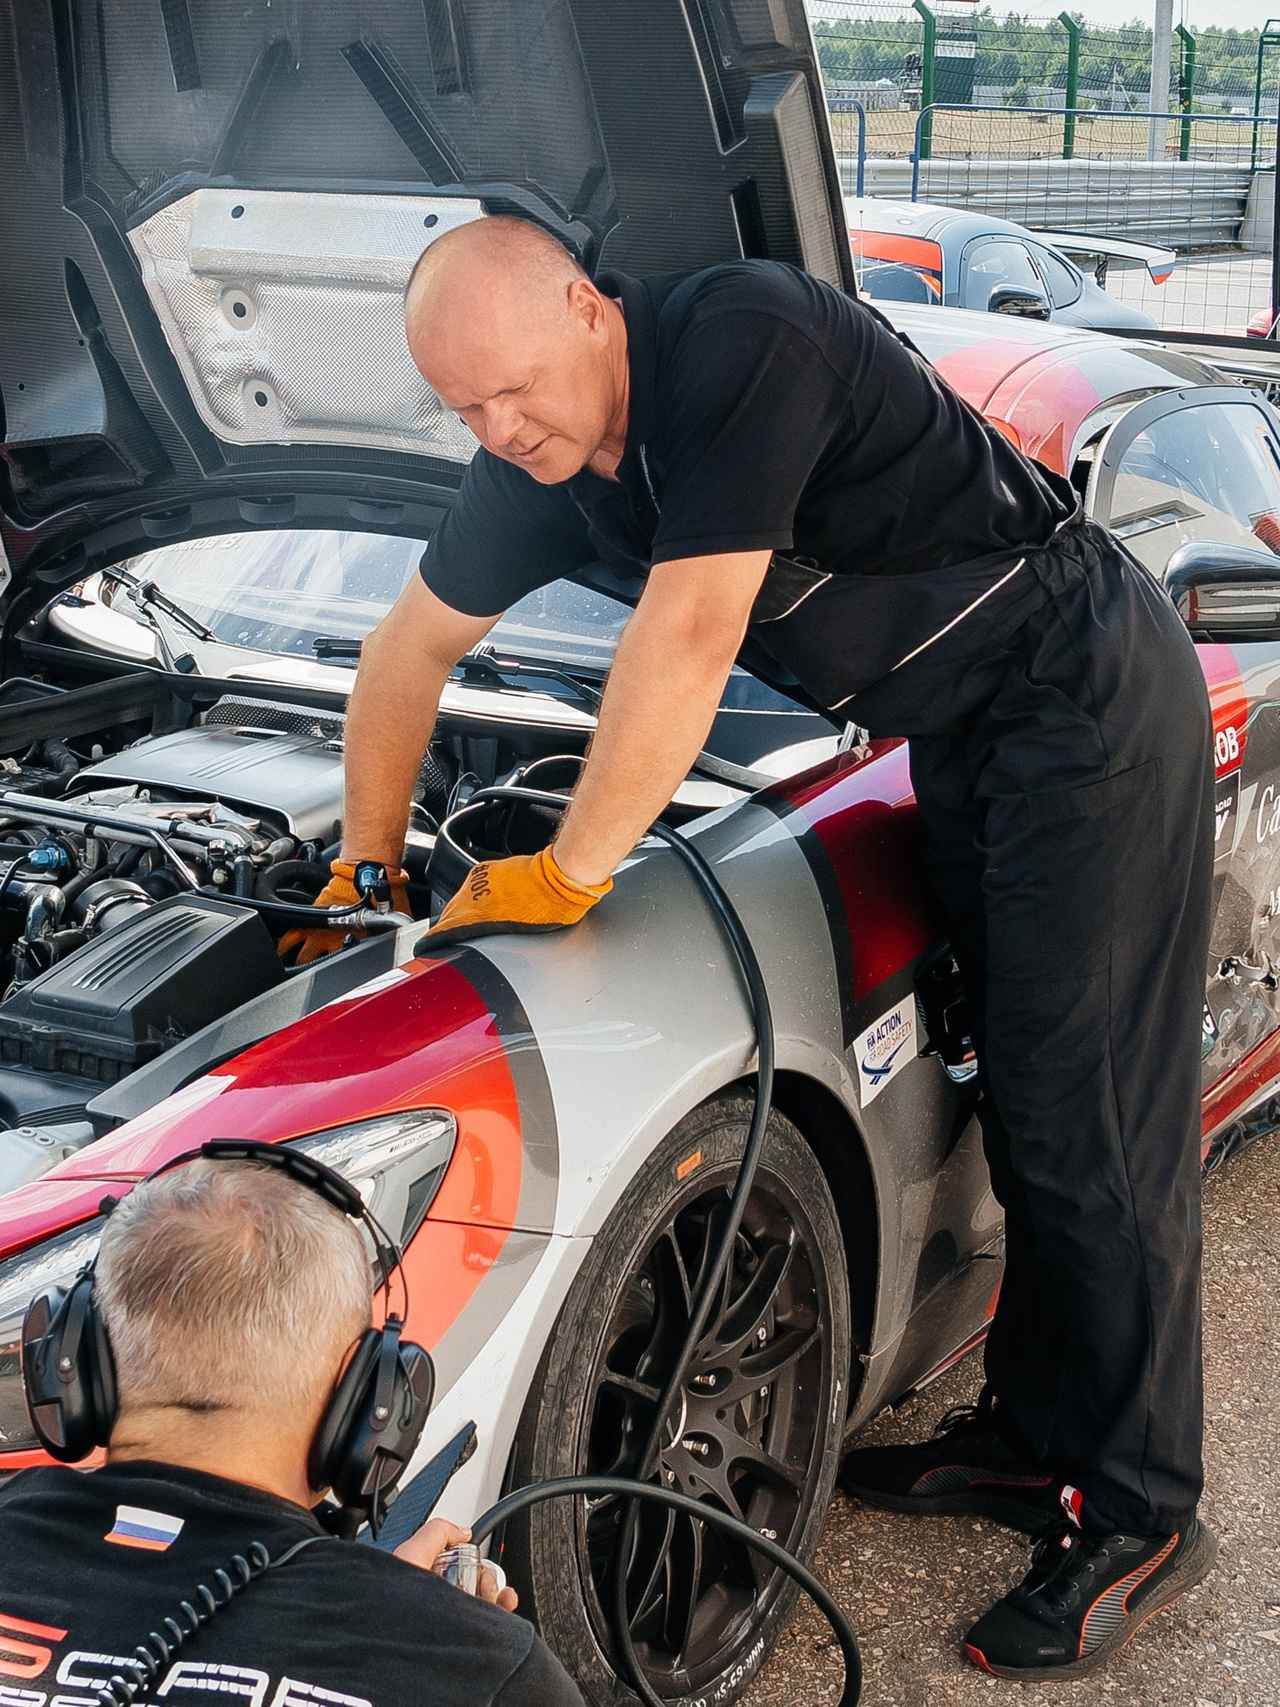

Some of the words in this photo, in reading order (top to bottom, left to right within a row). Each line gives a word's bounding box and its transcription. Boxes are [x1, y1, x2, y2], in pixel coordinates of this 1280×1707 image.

[876, 1010, 902, 1044] ACTION
[876, 1036, 892, 1060] ROAD
[891, 1018, 913, 1046] SAFETY
